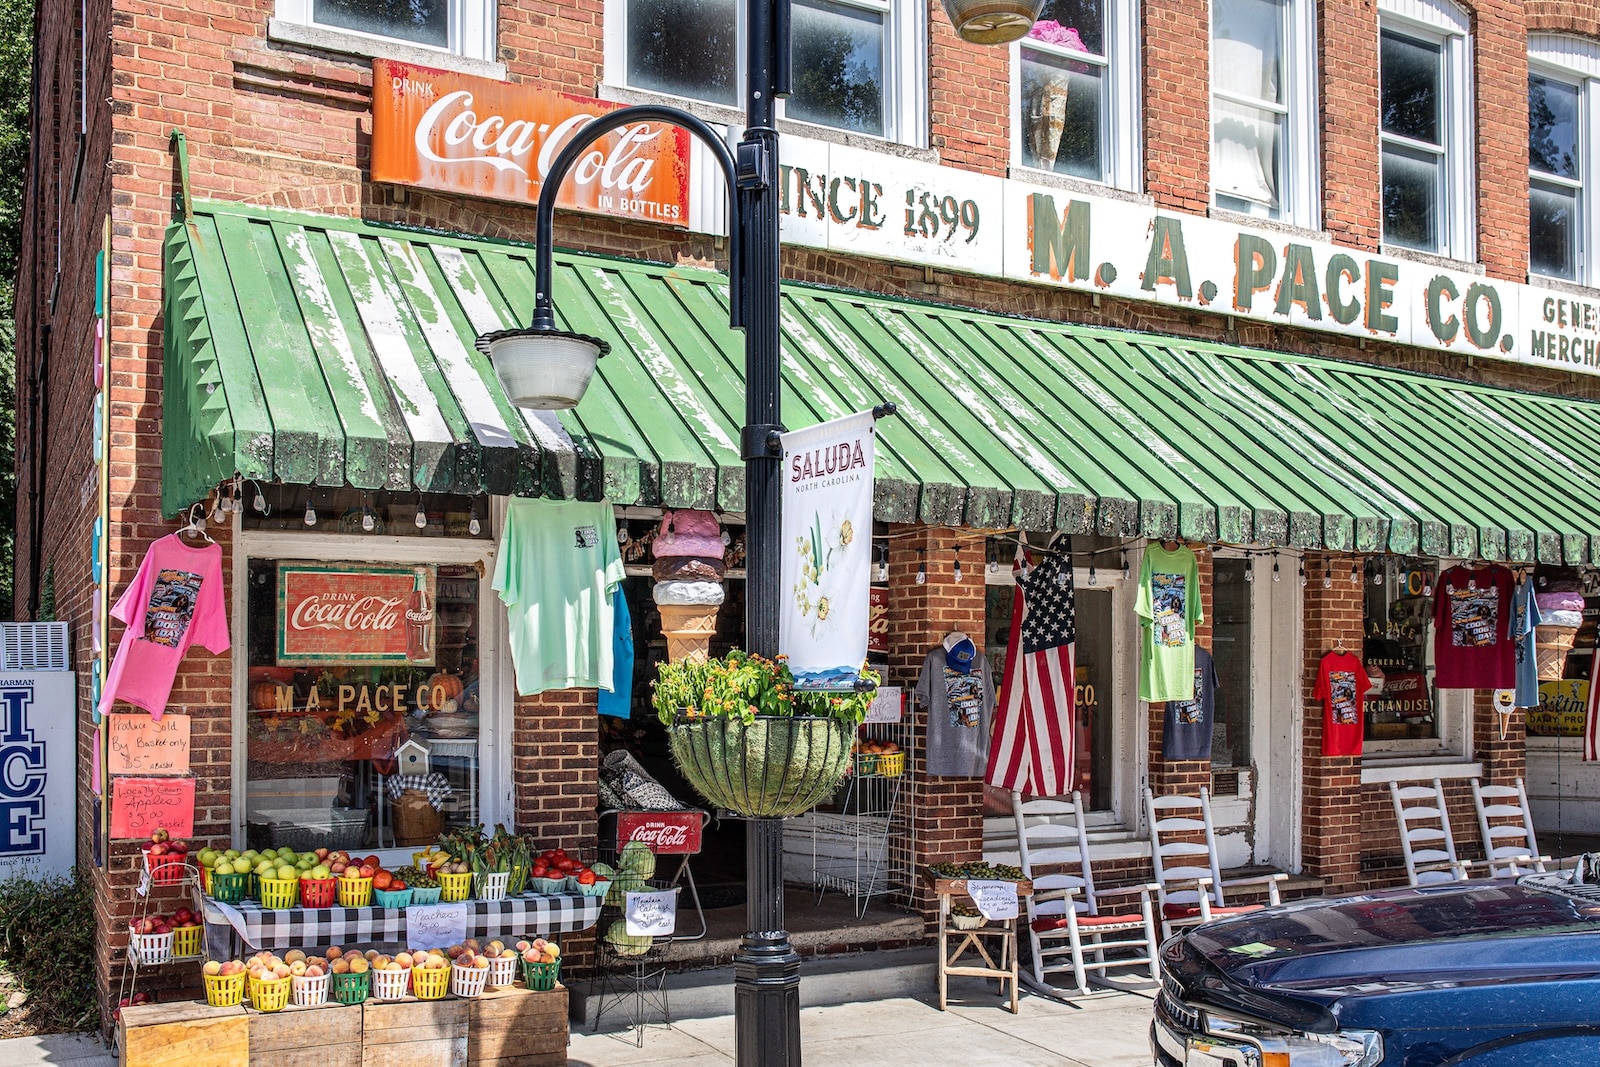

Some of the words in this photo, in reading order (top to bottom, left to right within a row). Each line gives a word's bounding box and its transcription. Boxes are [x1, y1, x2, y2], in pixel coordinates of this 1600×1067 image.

[392, 76, 434, 96] DRINK
[415, 90, 663, 193] Coca-Cola
[598, 194, 613, 208] IN
[620, 197, 680, 219] BOTTLES
[779, 164, 886, 231] INCE
[904, 189, 980, 244] 1899
[1027, 192, 1117, 289] M.
[1137, 216, 1218, 306] A.
[1233, 233, 1399, 337] PACE
[1424, 273, 1513, 355] CO.
[791, 439, 866, 482] SALUDA
[795, 482, 819, 493] NORTH
[821, 474, 861, 488] CAROLINA
[322, 592, 357, 601] DRINK
[291, 595, 404, 631] Coca-Cola
[405, 608, 433, 621] Coca-Cola
[1386, 621, 1416, 640] PACE
[1367, 658, 1406, 666] GENERAL
[338, 684, 408, 712] PACE
[1075, 684, 1098, 706] CO.
[1538, 692, 1585, 713] Biltm
[1363, 699, 1429, 713] RCHANDISE
[112, 714, 147, 731] Produce
[151, 718, 178, 733] Sold
[1565, 716, 1584, 724] PRO
[112, 735, 129, 754] By
[136, 736, 166, 748] Basket
[0, 686, 47, 857] ICE
[124, 796, 182, 811] Apples
[630, 825, 689, 846] Coca-Cola
[412, 908, 459, 922] Peaches
